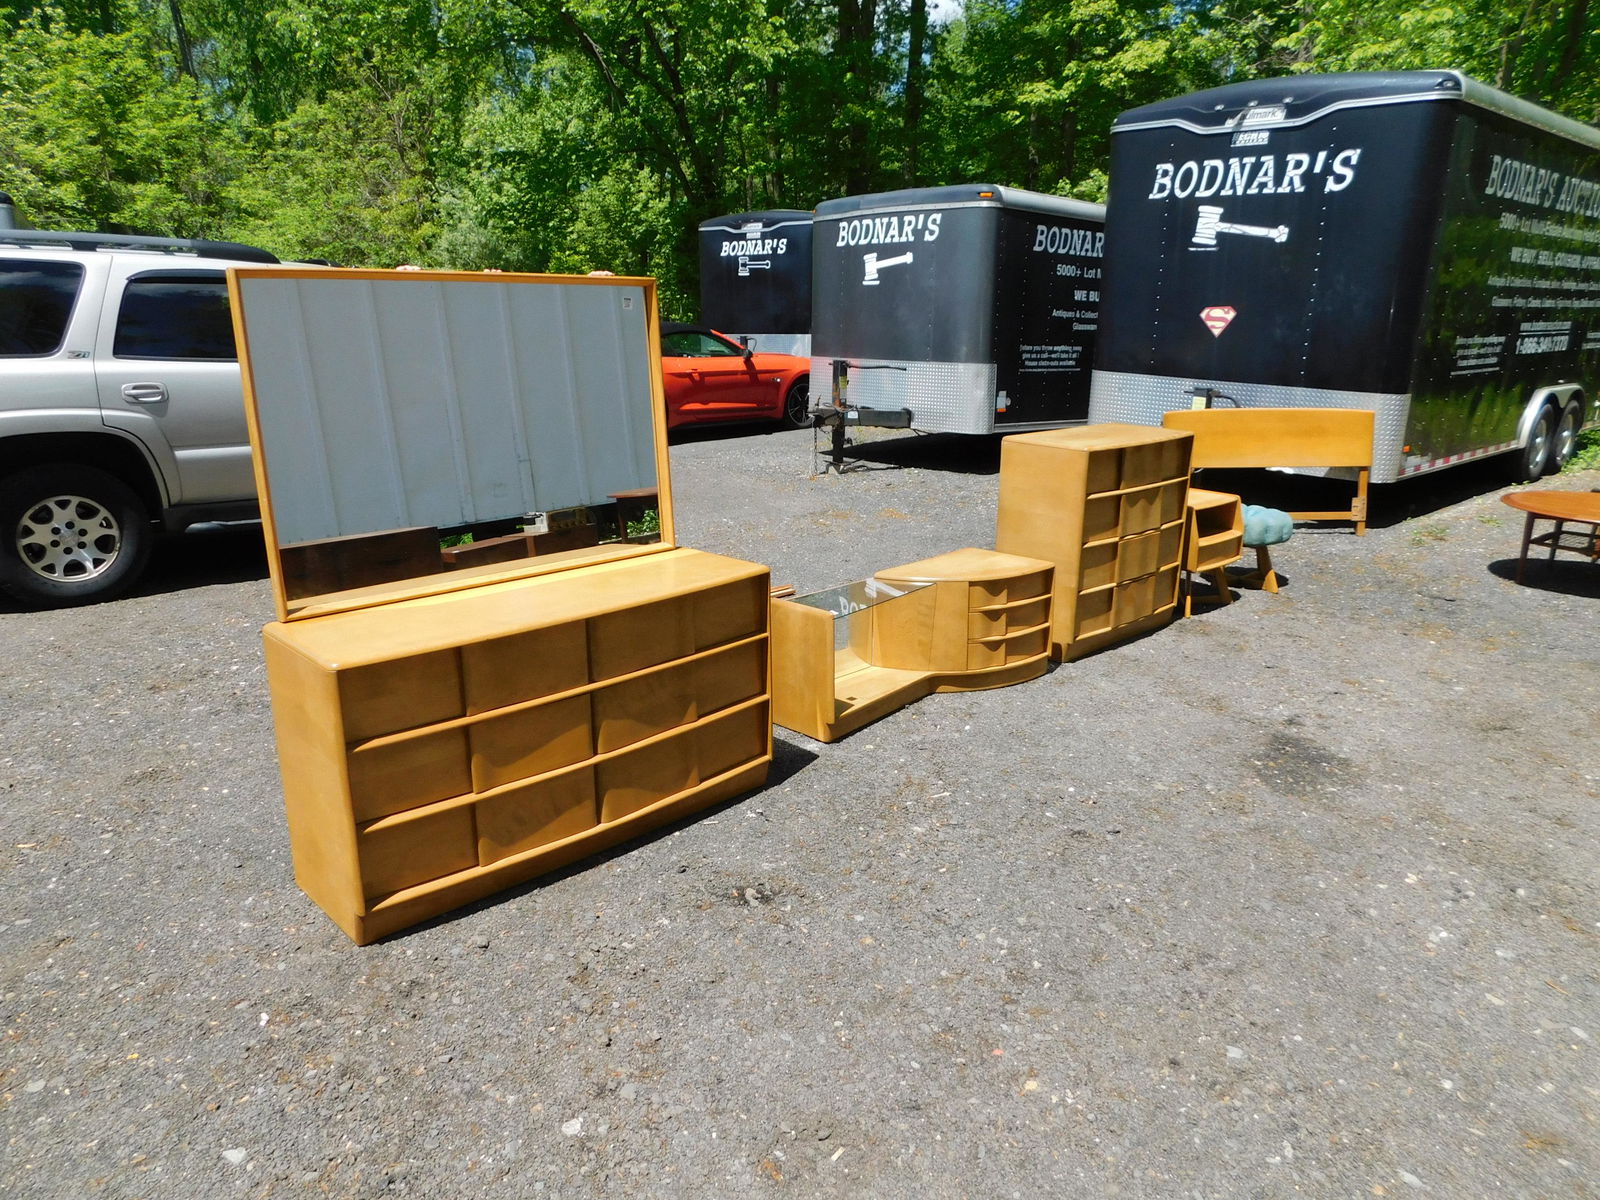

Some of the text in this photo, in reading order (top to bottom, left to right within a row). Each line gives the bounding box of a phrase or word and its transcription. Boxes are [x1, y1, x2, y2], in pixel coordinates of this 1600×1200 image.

[1148, 149, 1362, 199] BODNAR'S
[1485, 154, 1560, 208] BODNAR'S
[836, 213, 942, 247] BODNAR'S
[720, 238, 787, 256] BODNAR'S
[1056, 263, 1081, 277] 5000+
[1083, 267, 1096, 278] Lot
[1074, 289, 1087, 301] WE
